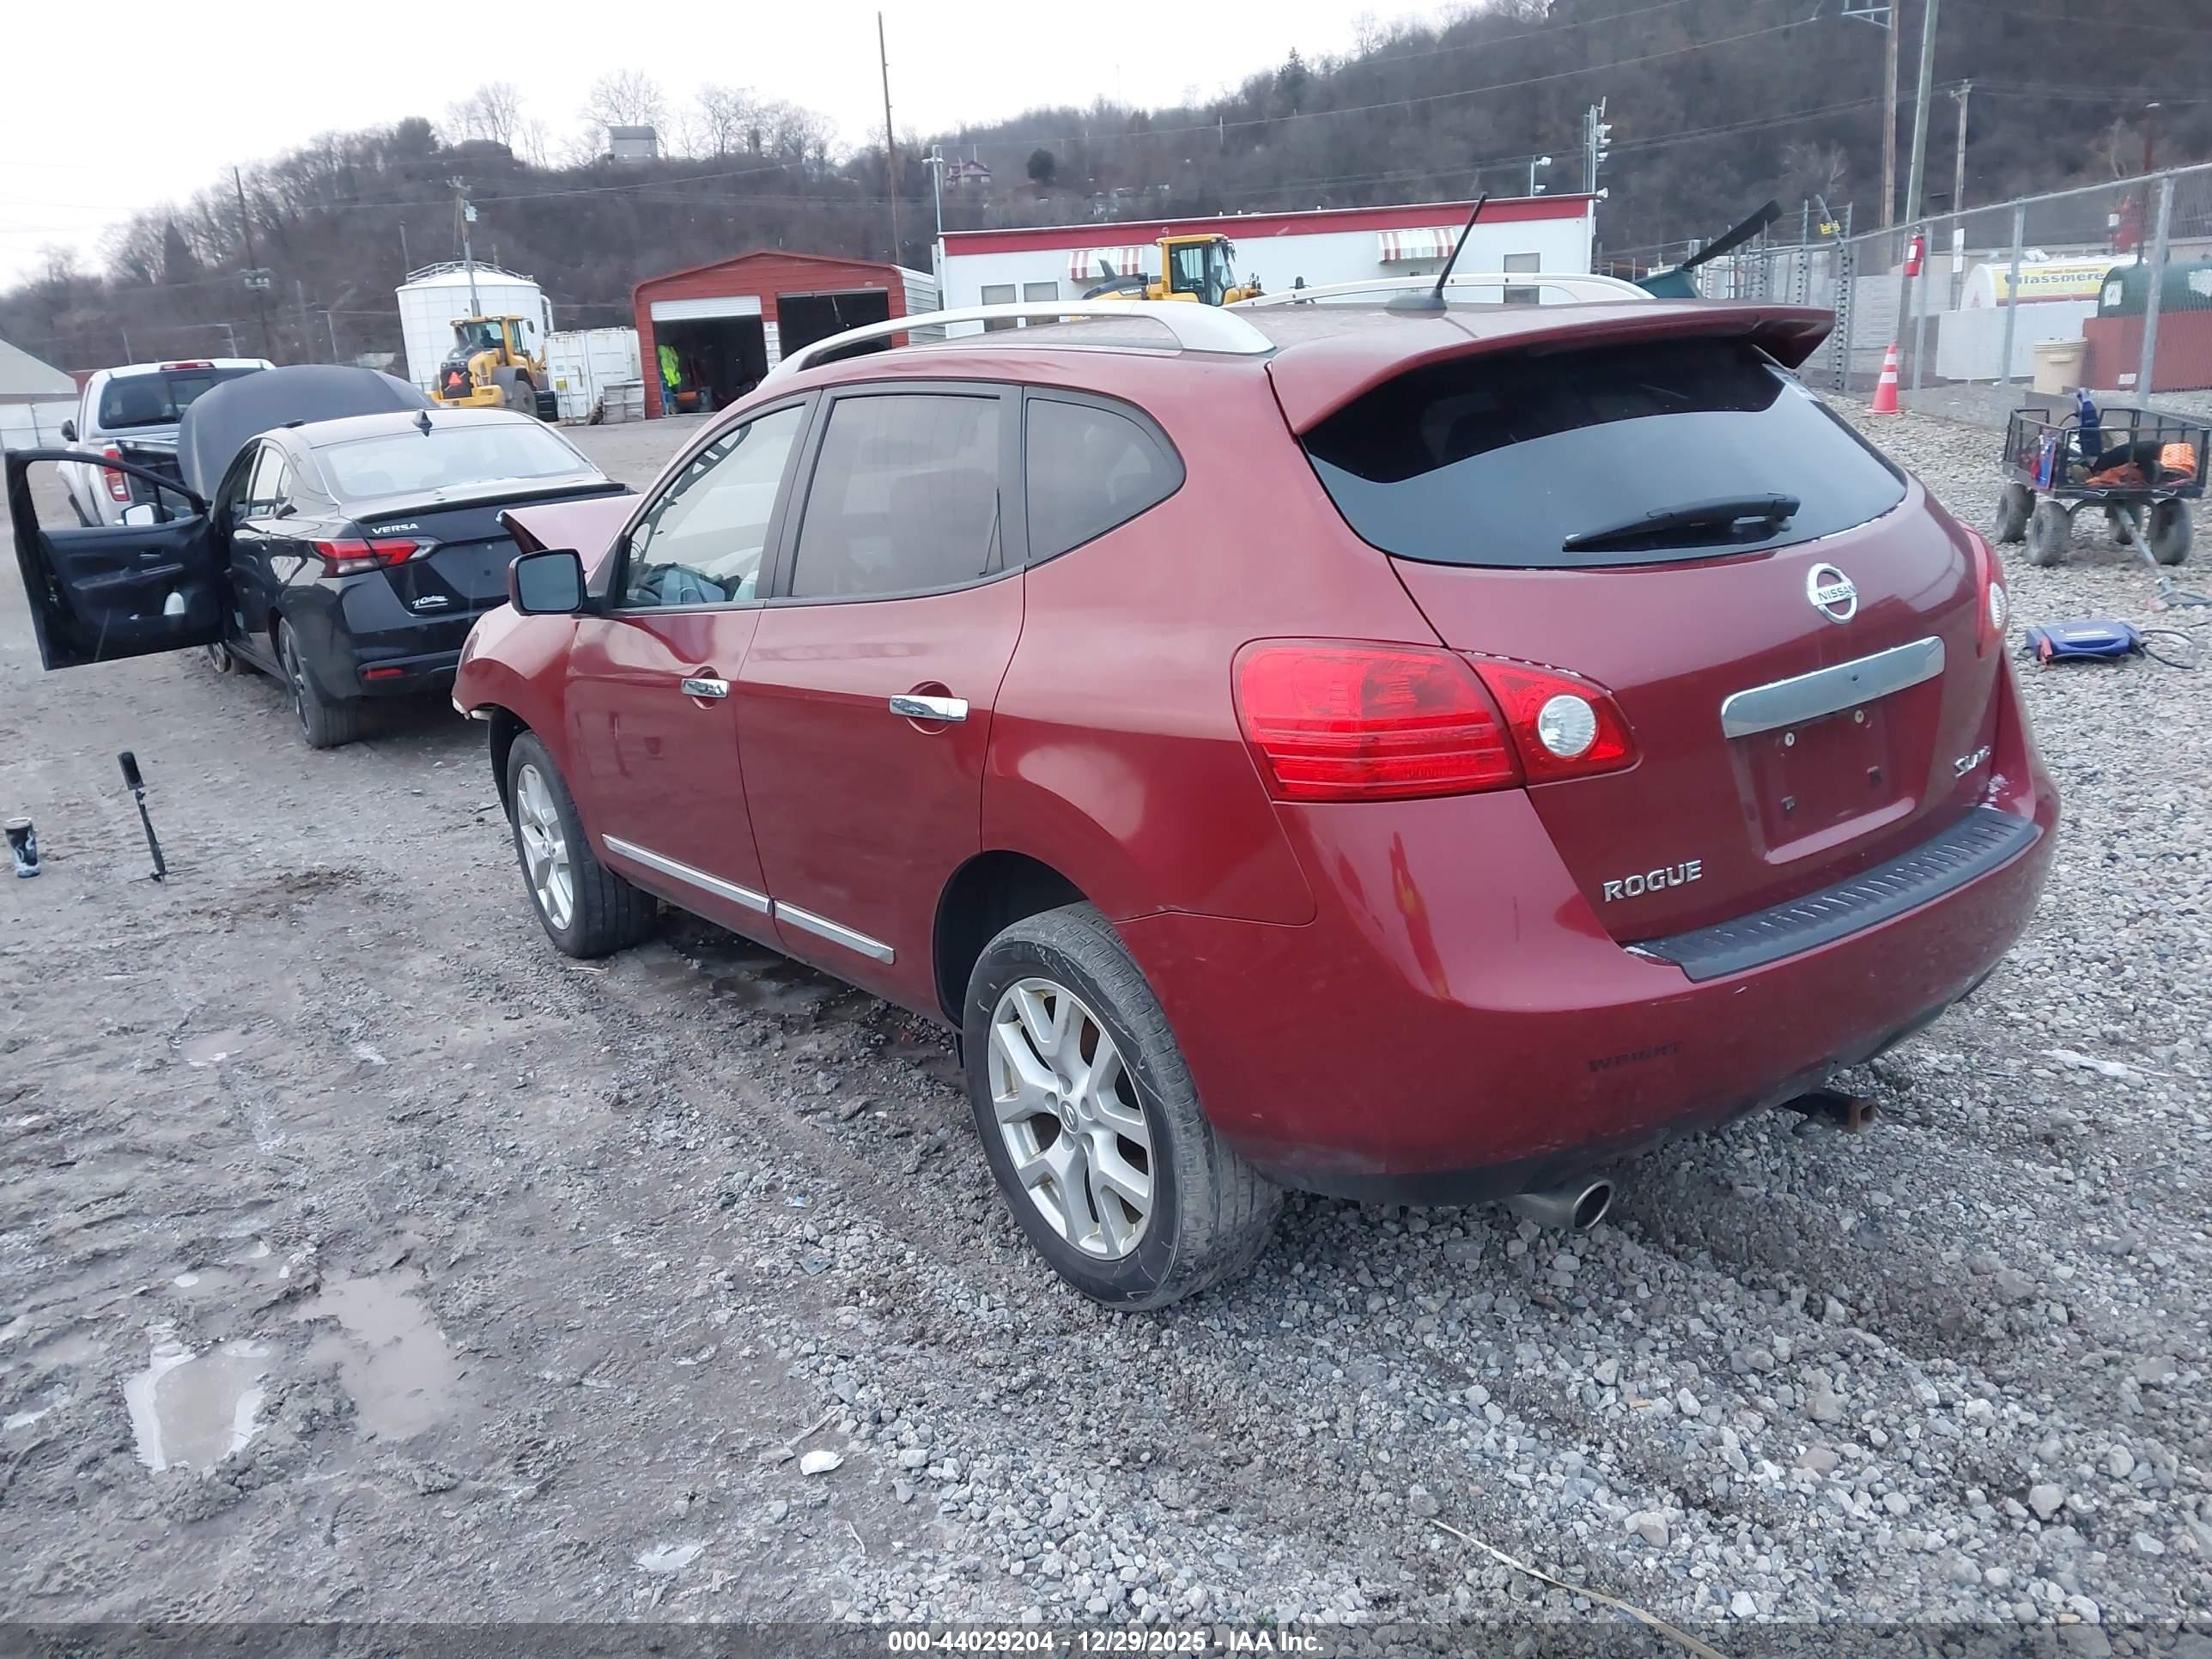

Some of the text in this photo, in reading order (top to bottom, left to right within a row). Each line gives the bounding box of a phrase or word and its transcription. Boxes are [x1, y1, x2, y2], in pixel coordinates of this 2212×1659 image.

[371, 523, 419, 534] VERSA
[1817, 585, 1856, 601] NISSAN
[1602, 860, 1702, 902] ROGUE
